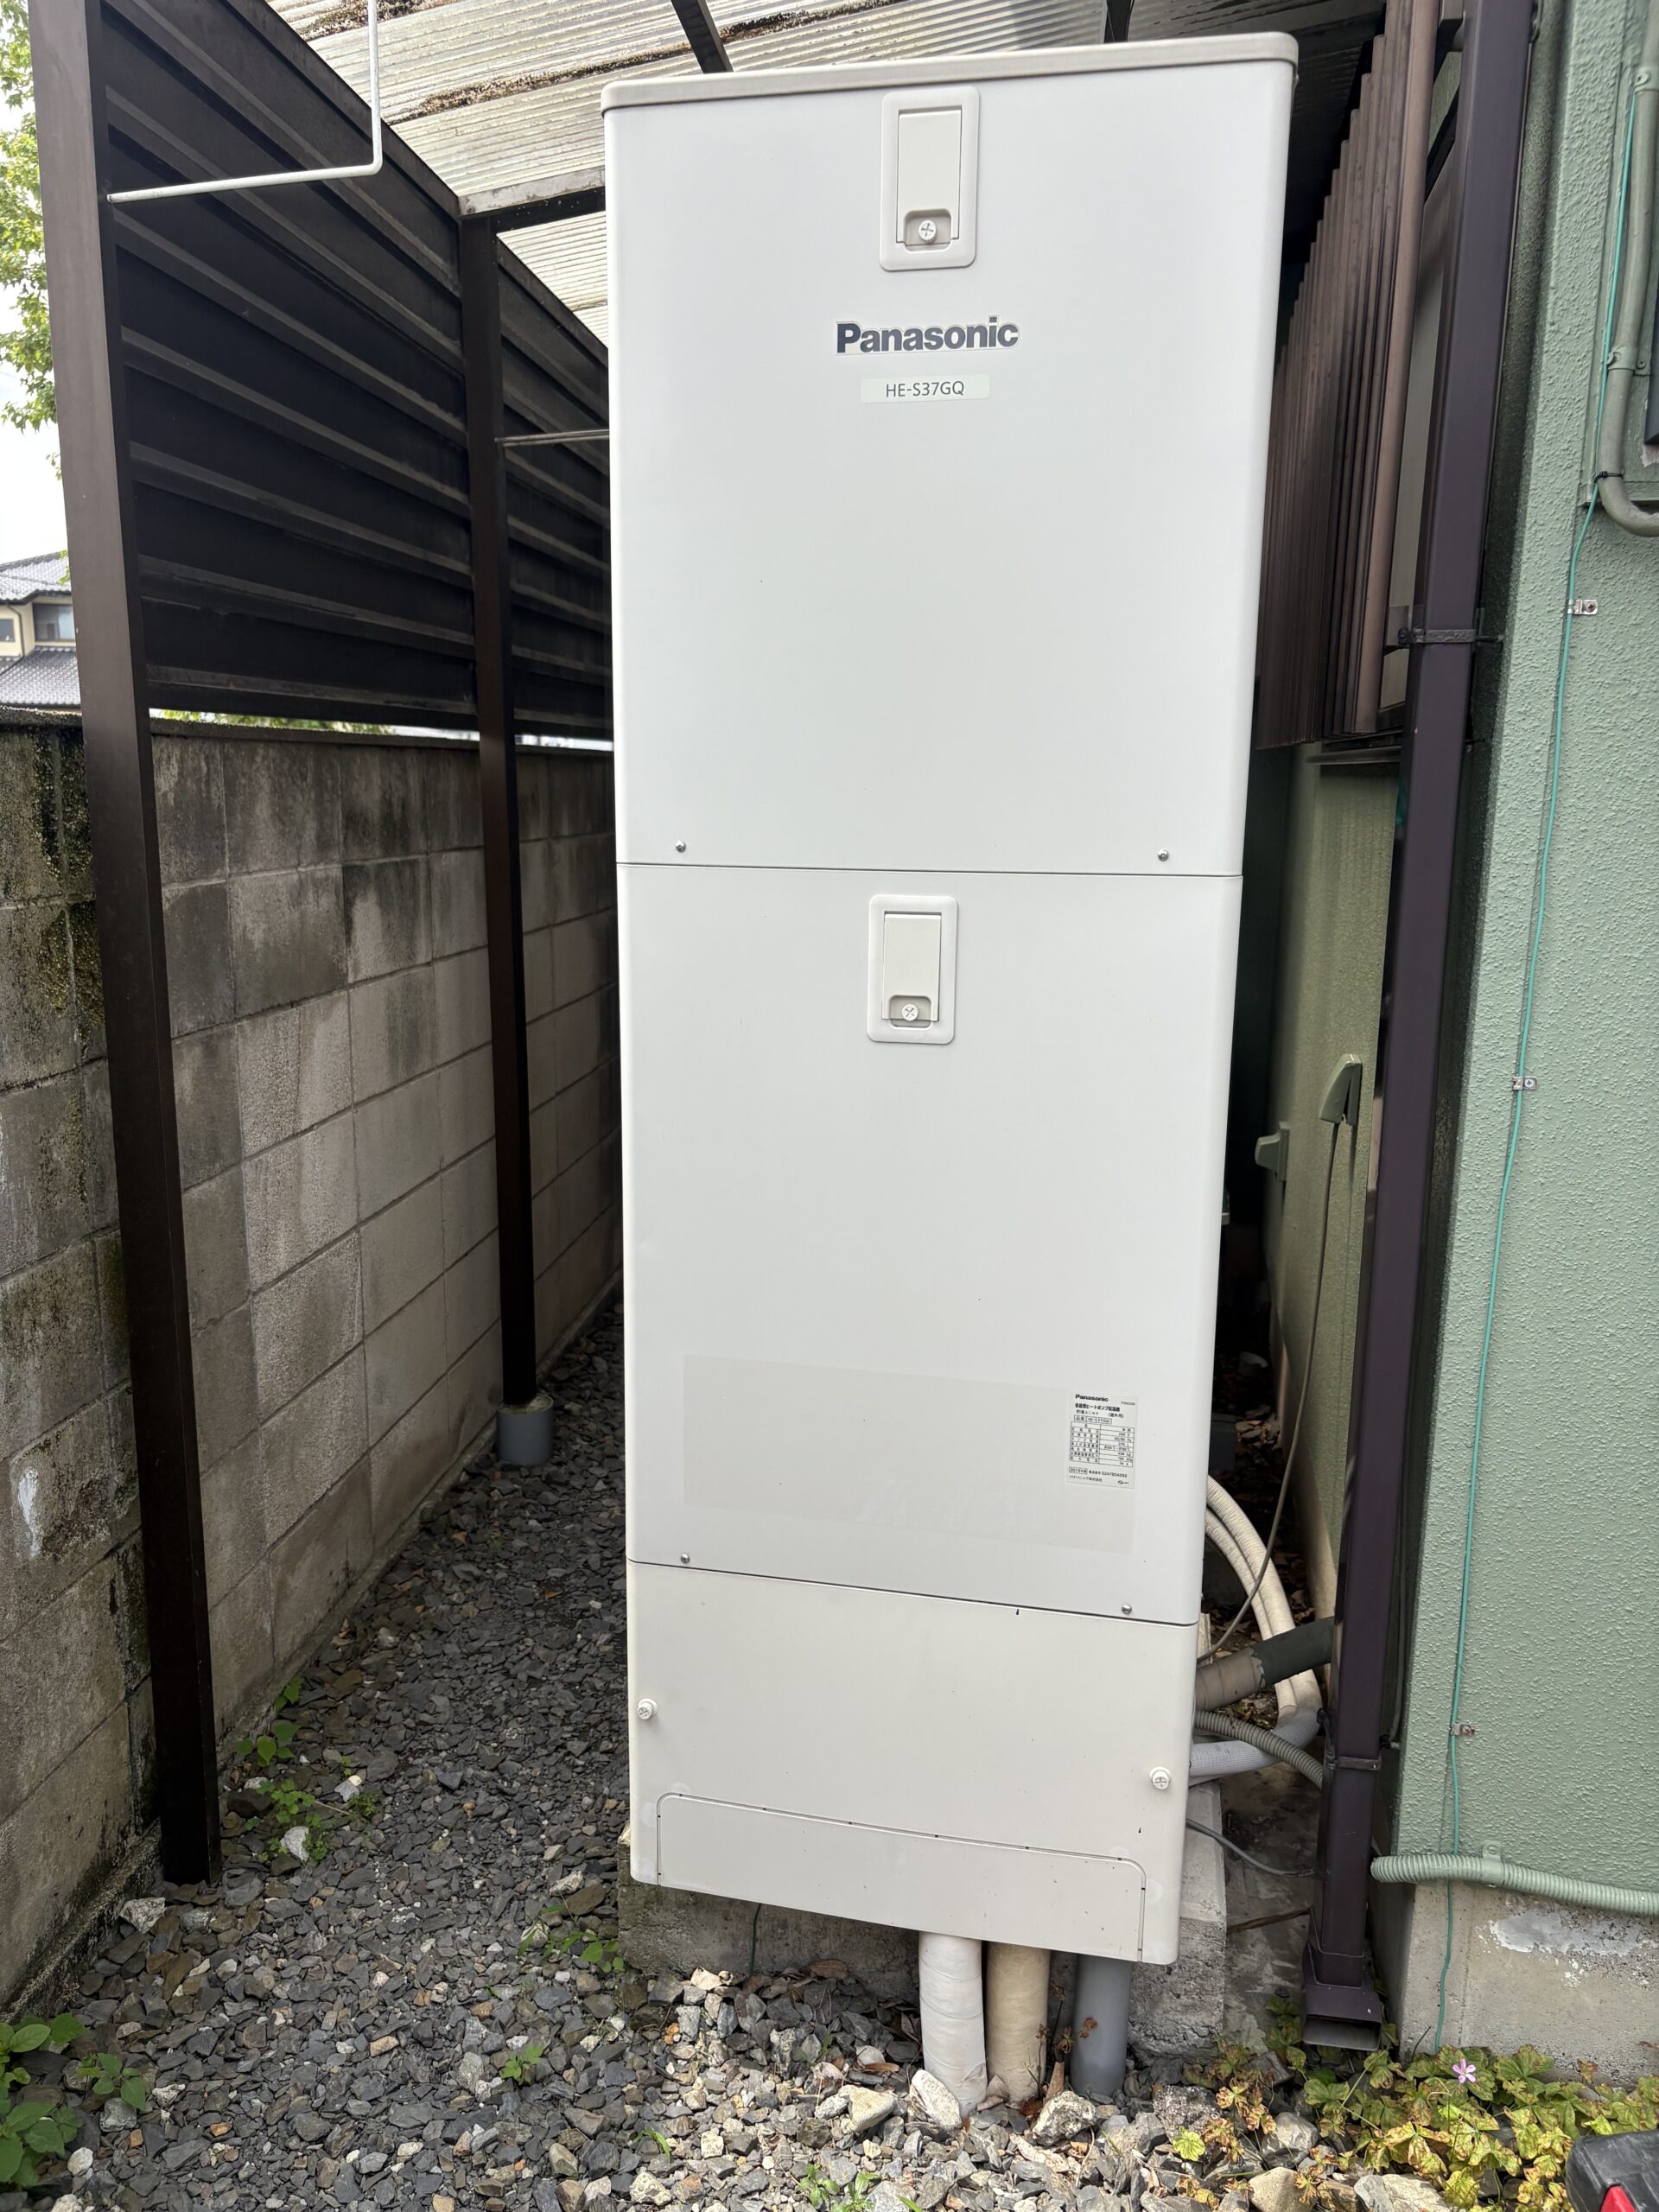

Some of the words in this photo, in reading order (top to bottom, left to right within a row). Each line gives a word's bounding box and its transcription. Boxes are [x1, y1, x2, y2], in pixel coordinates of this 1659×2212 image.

[836, 316, 1019, 353] Panasonic
[886, 381, 964, 397] HE-S37GQ
[1075, 1394, 1109, 1402] Panasonic
